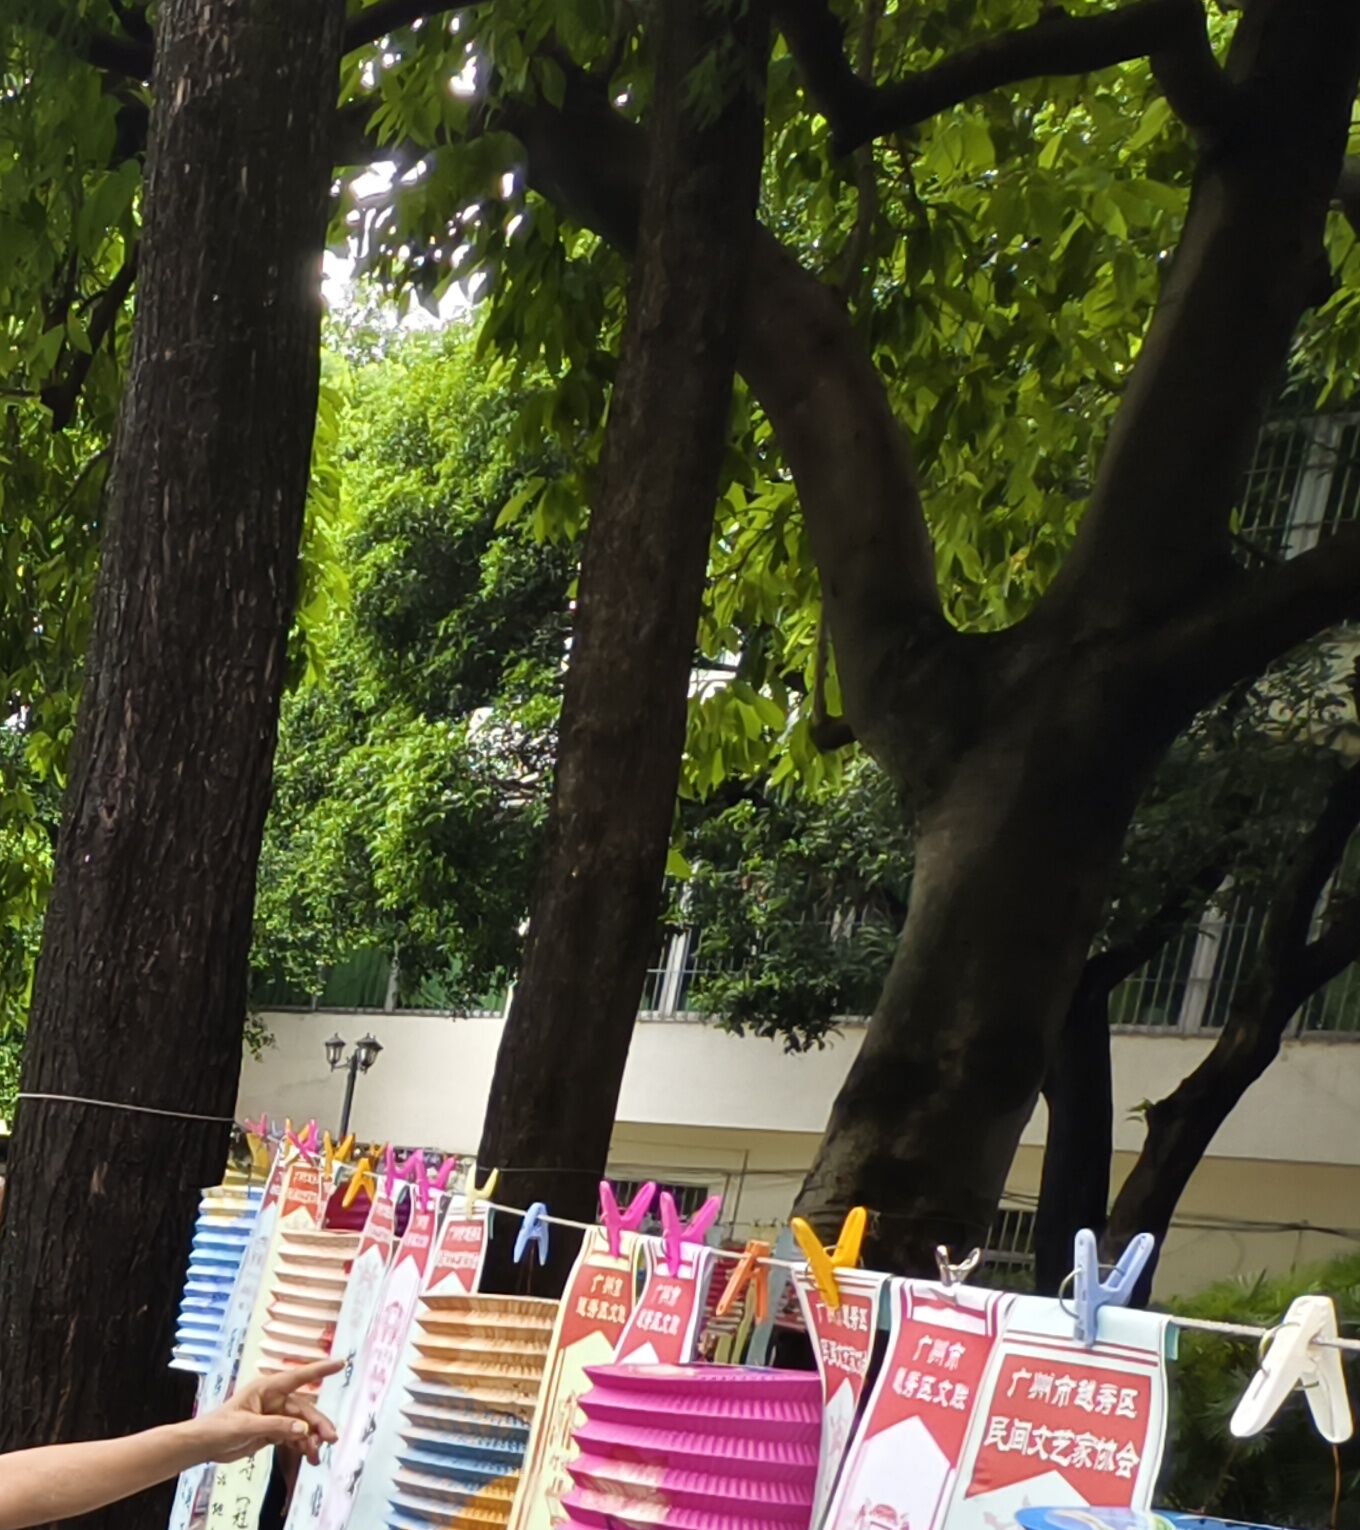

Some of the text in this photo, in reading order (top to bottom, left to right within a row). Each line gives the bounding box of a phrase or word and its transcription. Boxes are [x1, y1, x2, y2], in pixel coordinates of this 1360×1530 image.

[911, 1334, 966, 1370] 广州市
[1006, 1367, 1140, 1419] 广州市越秀区
[983, 1415, 1141, 1479] 民间文艺家协会
